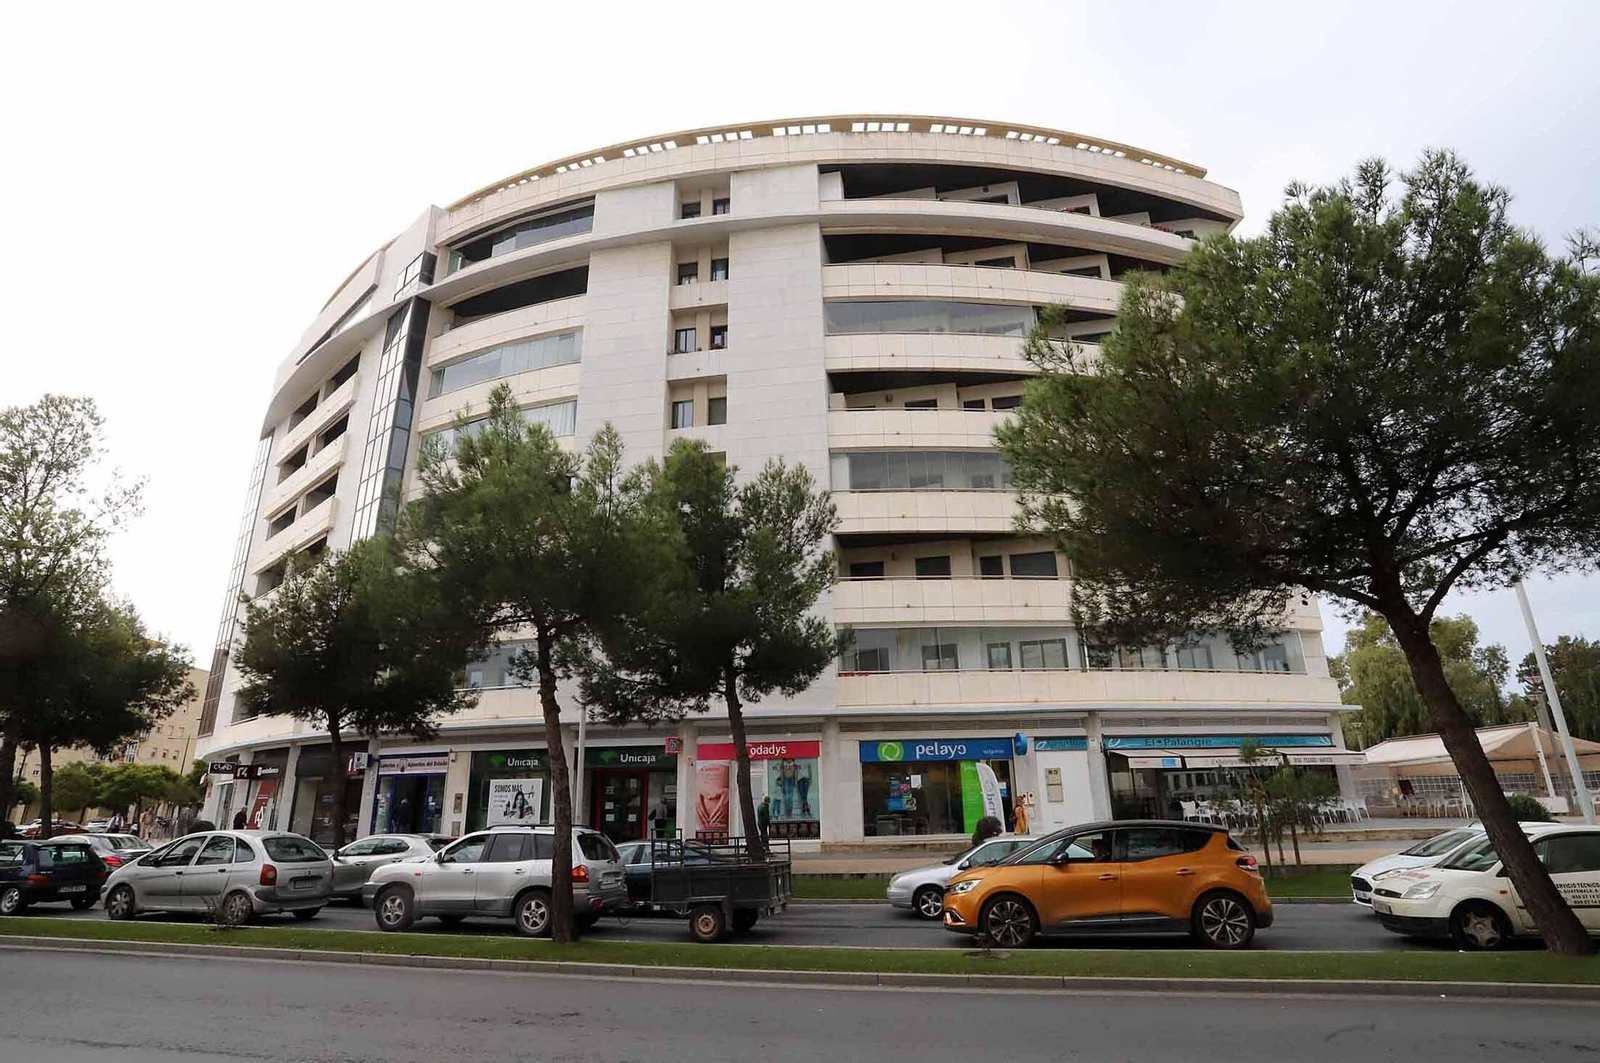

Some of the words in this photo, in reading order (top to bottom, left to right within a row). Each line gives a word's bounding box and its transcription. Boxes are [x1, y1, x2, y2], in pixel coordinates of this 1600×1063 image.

[1164, 738, 1212, 748] Palangre
[915, 742, 967, 760] pelayo
[507, 757, 540, 768] Unicaja
[620, 753, 657, 764] Unicaja
[494, 784, 511, 793] SOMOS
